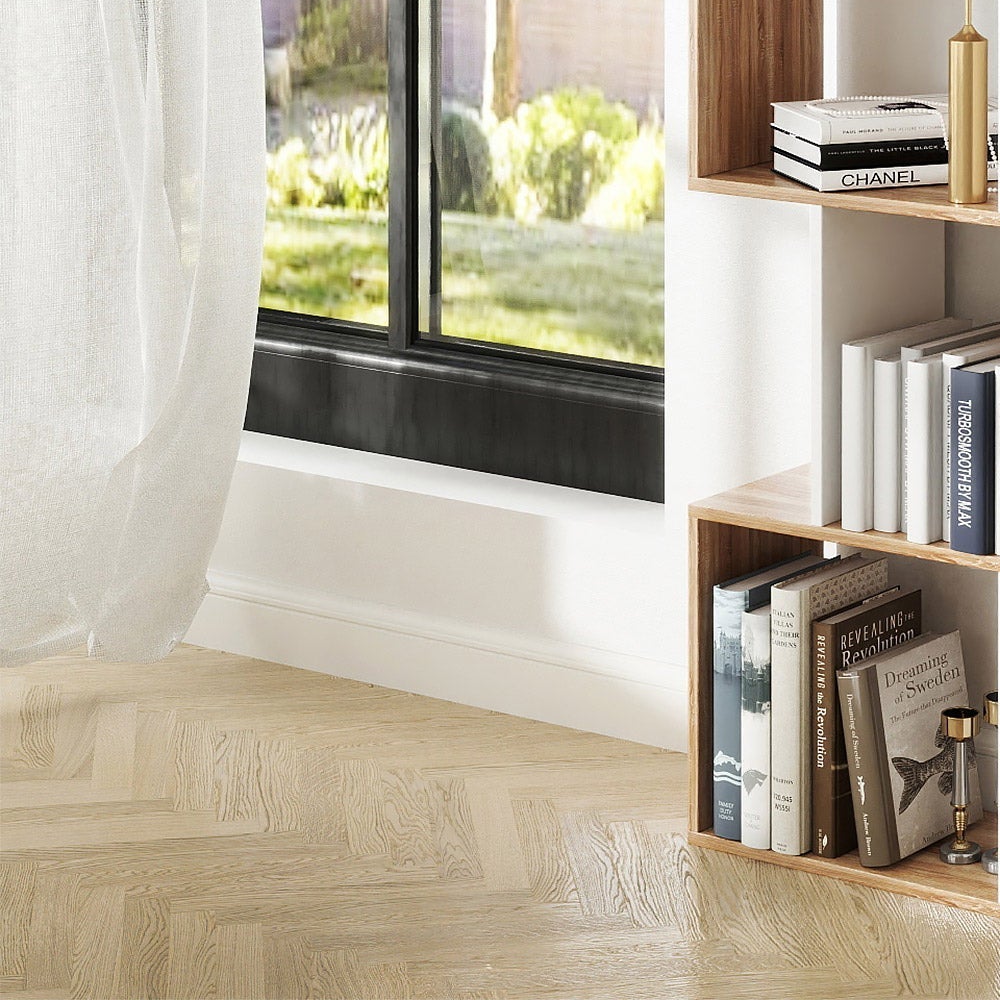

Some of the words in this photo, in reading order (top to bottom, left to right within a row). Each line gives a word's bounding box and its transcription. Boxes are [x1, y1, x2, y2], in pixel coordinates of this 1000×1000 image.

[841, 170, 920, 187] CHANEL
[958, 399, 972, 483] TURBOSMOOTH
[958, 484, 972, 500] BY
[841, 611, 903, 650] REVEALING
[904, 611, 914, 621] THE
[842, 628, 914, 667] Revolution
[817, 635, 826, 689] REVEALING
[884, 650, 950, 688] Dreaming
[894, 691, 904, 705] of
[905, 665, 961, 699] Sweden
[846, 694, 856, 730] Dreaming
[817, 707, 827, 768] Revolution
[852, 731, 859, 739] of
[852, 739, 861, 769] Sweden
